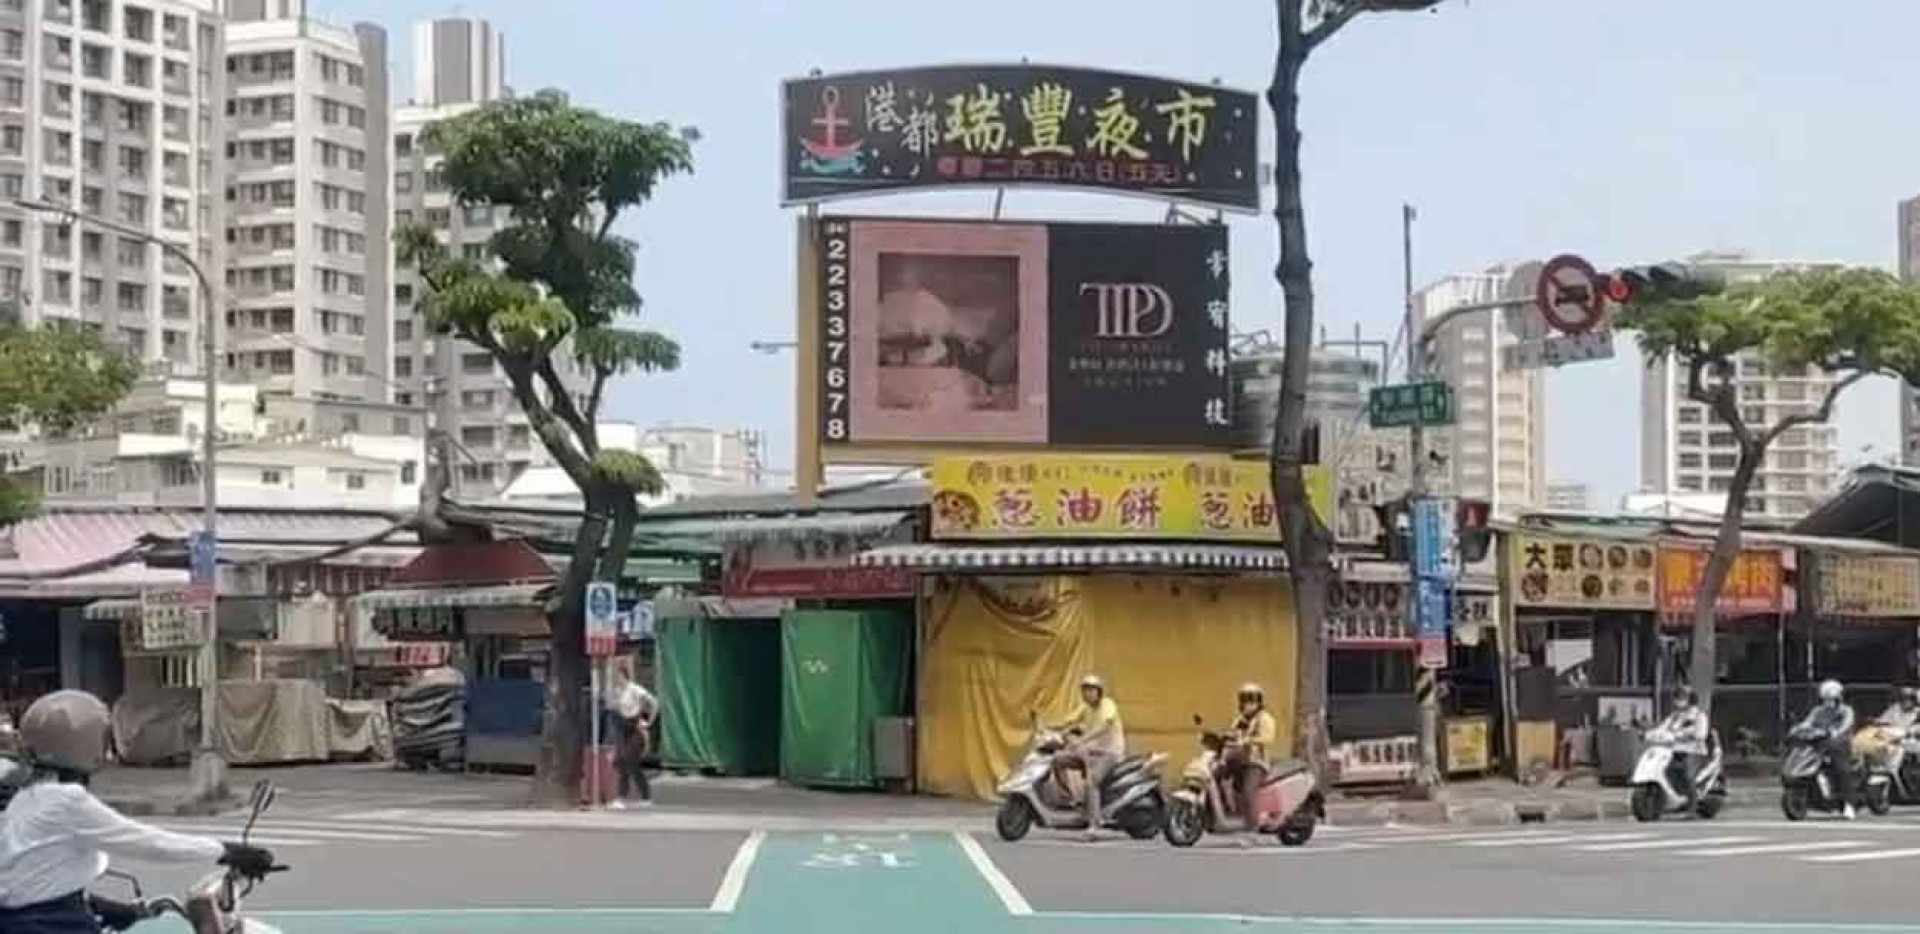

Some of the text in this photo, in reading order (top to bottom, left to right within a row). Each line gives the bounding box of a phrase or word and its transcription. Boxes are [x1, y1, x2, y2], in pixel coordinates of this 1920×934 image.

[944, 83, 1216, 161] 瑞豐夜市
[826, 239, 847, 440] 22337678
